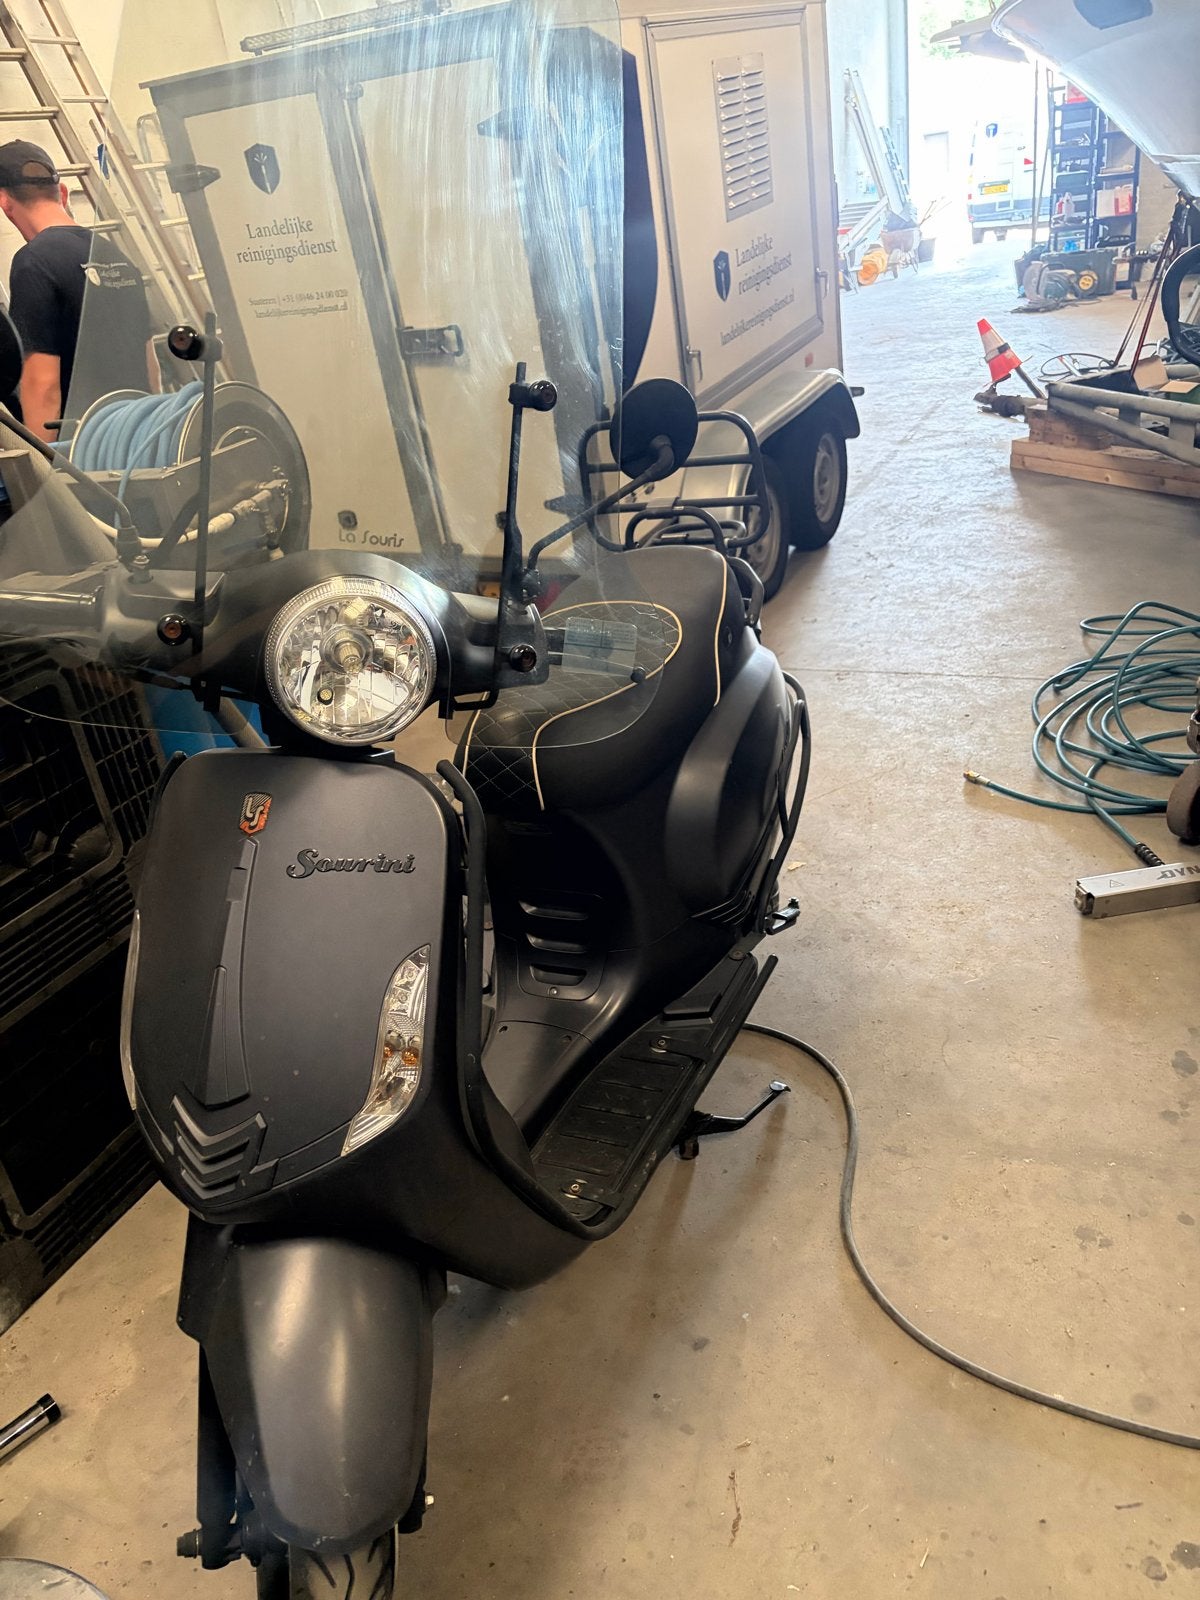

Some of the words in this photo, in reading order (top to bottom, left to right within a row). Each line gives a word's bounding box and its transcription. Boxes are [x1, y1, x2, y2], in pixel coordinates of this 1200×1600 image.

[245, 216, 314, 239] Landelijke
[236, 239, 338, 265] reinigingsdienst
[361, 530, 405, 548] Souris
[286, 848, 416, 879] Sourini
